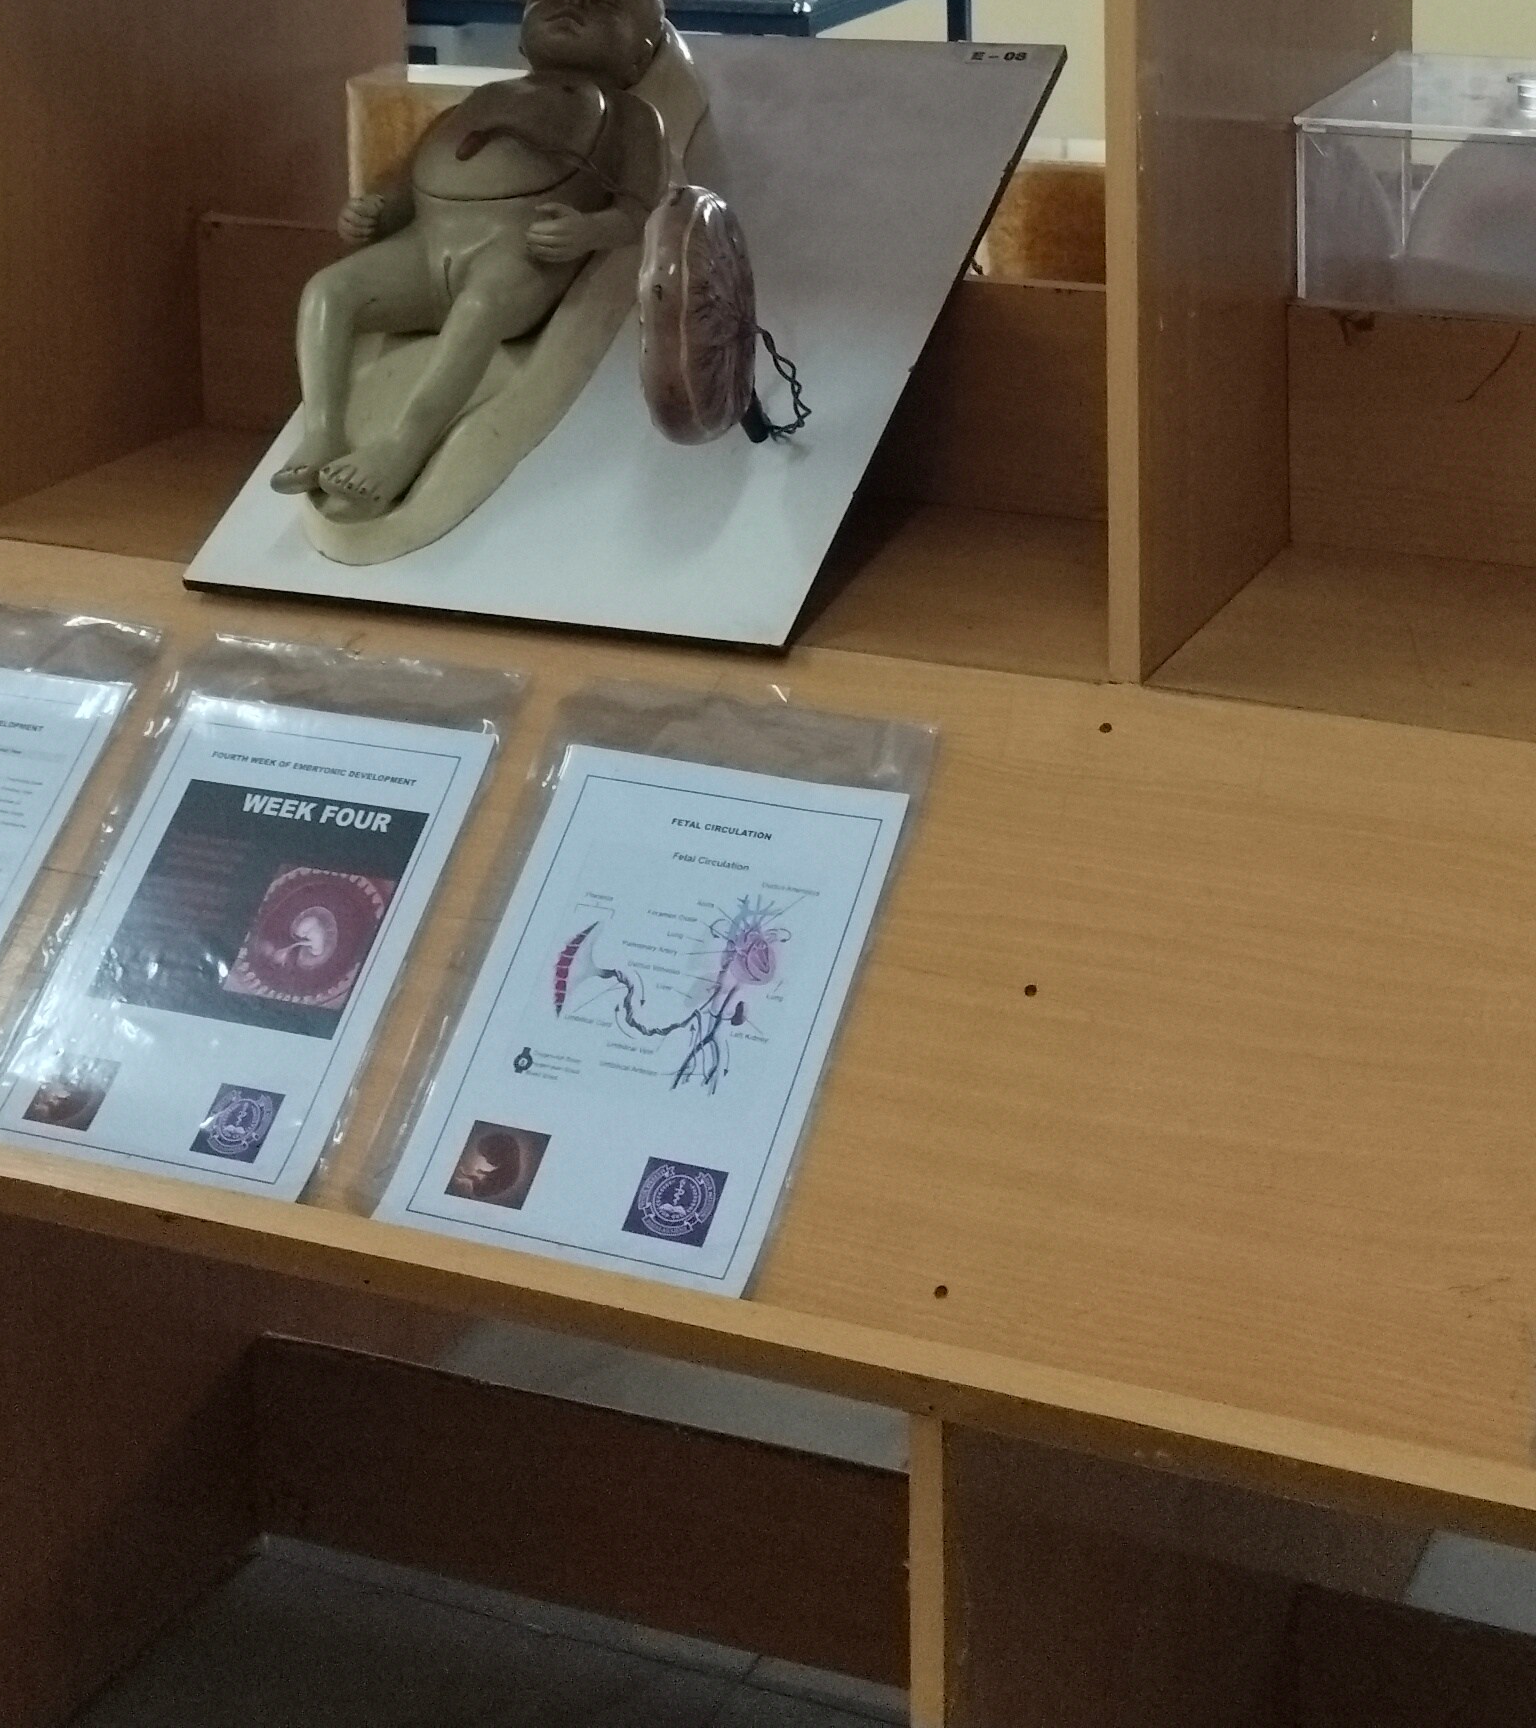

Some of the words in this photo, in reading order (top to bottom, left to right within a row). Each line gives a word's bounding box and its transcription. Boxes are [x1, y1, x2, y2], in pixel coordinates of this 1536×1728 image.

[212, 751, 249, 763] FOURTH
[250, 756, 277, 767] WEEK
[278, 760, 292, 768] OF
[293, 762, 347, 777] EMBRYONIC
[348, 770, 417, 787] DEVELOPMENT
[242, 793, 317, 821] WEEK
[319, 805, 392, 833] FOUR
[671, 817, 701, 830] FETAL
[704, 823, 773, 841] CIRCULATION
[672, 851, 696, 863] Fetal
[697, 856, 750, 871] Circulation
